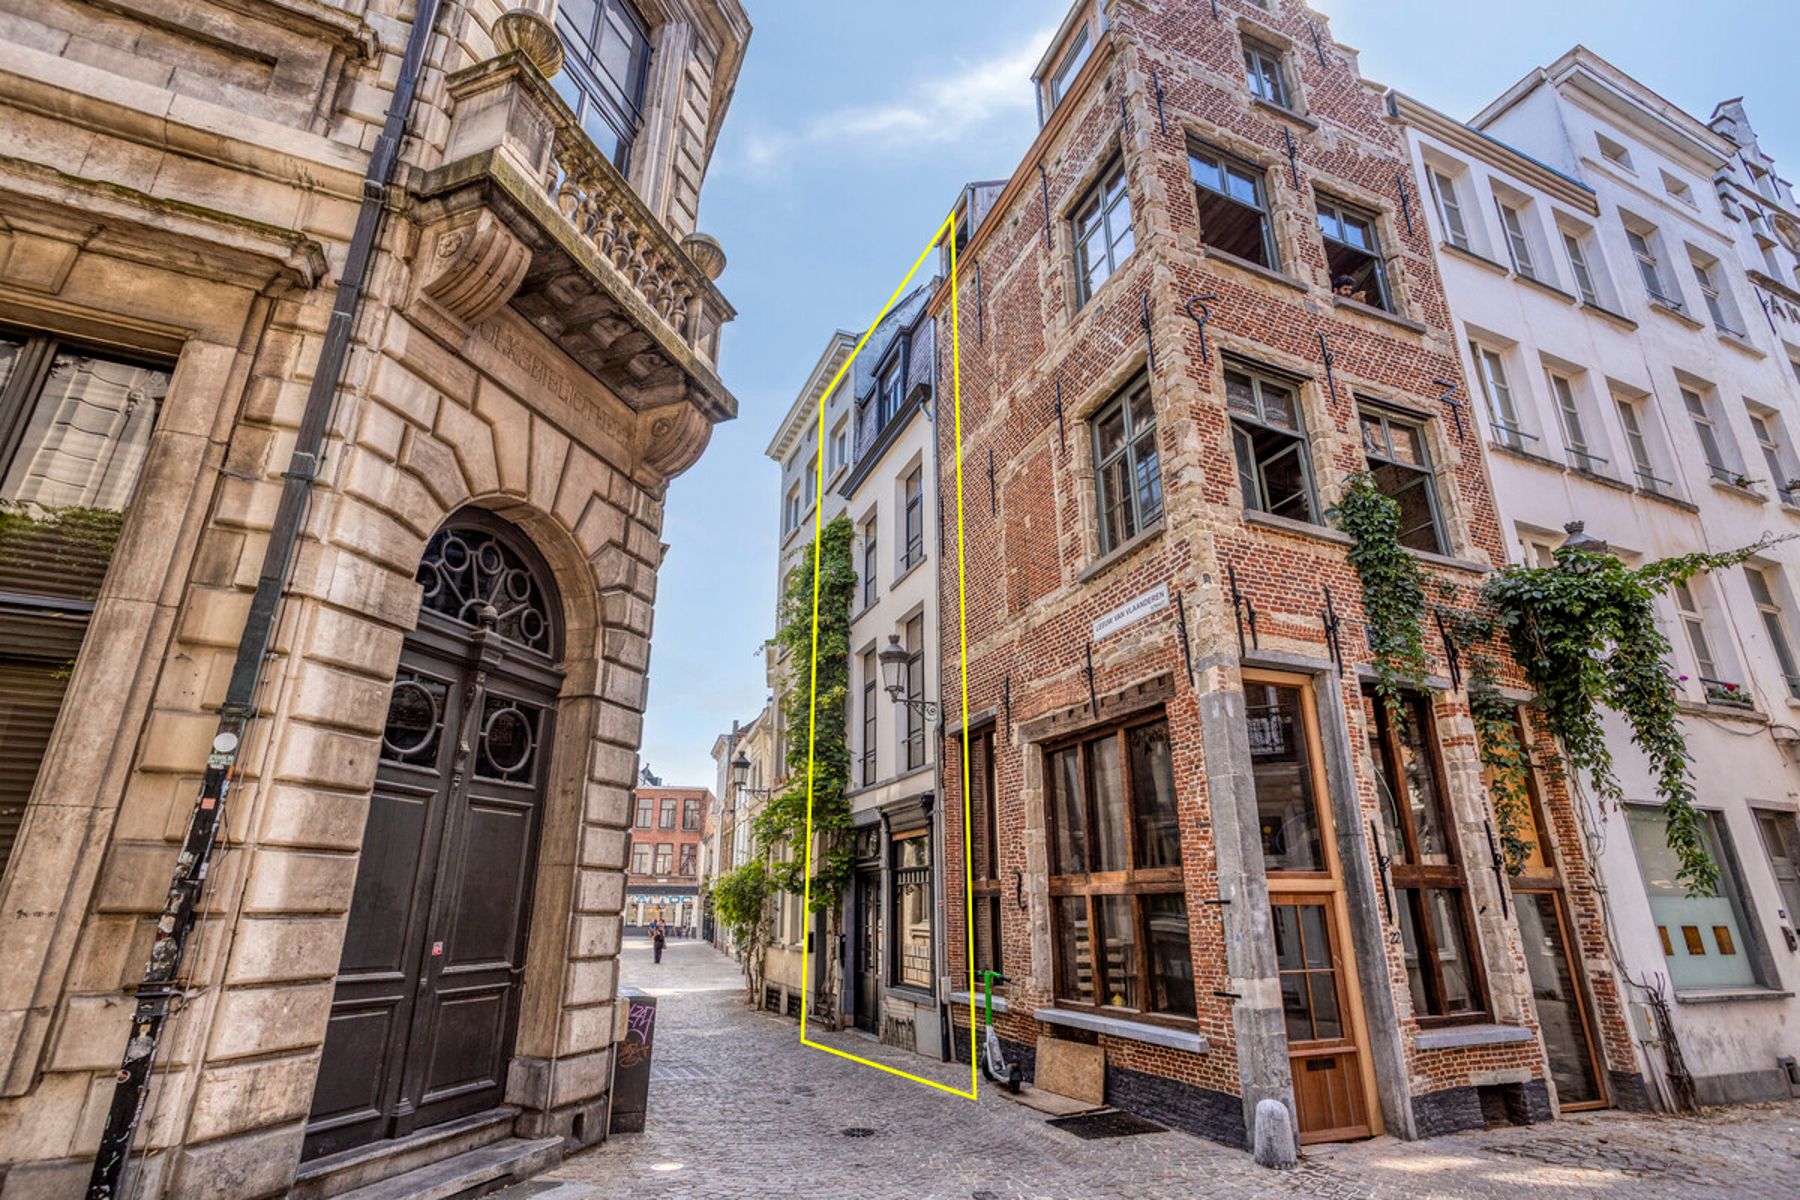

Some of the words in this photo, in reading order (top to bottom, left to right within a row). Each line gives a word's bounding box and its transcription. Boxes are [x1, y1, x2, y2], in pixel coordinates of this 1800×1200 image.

[471, 318, 635, 451] OLKSBIBLIOTHEEK
[1114, 611, 1126, 621] VAN
[1125, 590, 1165, 615] VLAANDEREN
[1389, 931, 1401, 945] 22
